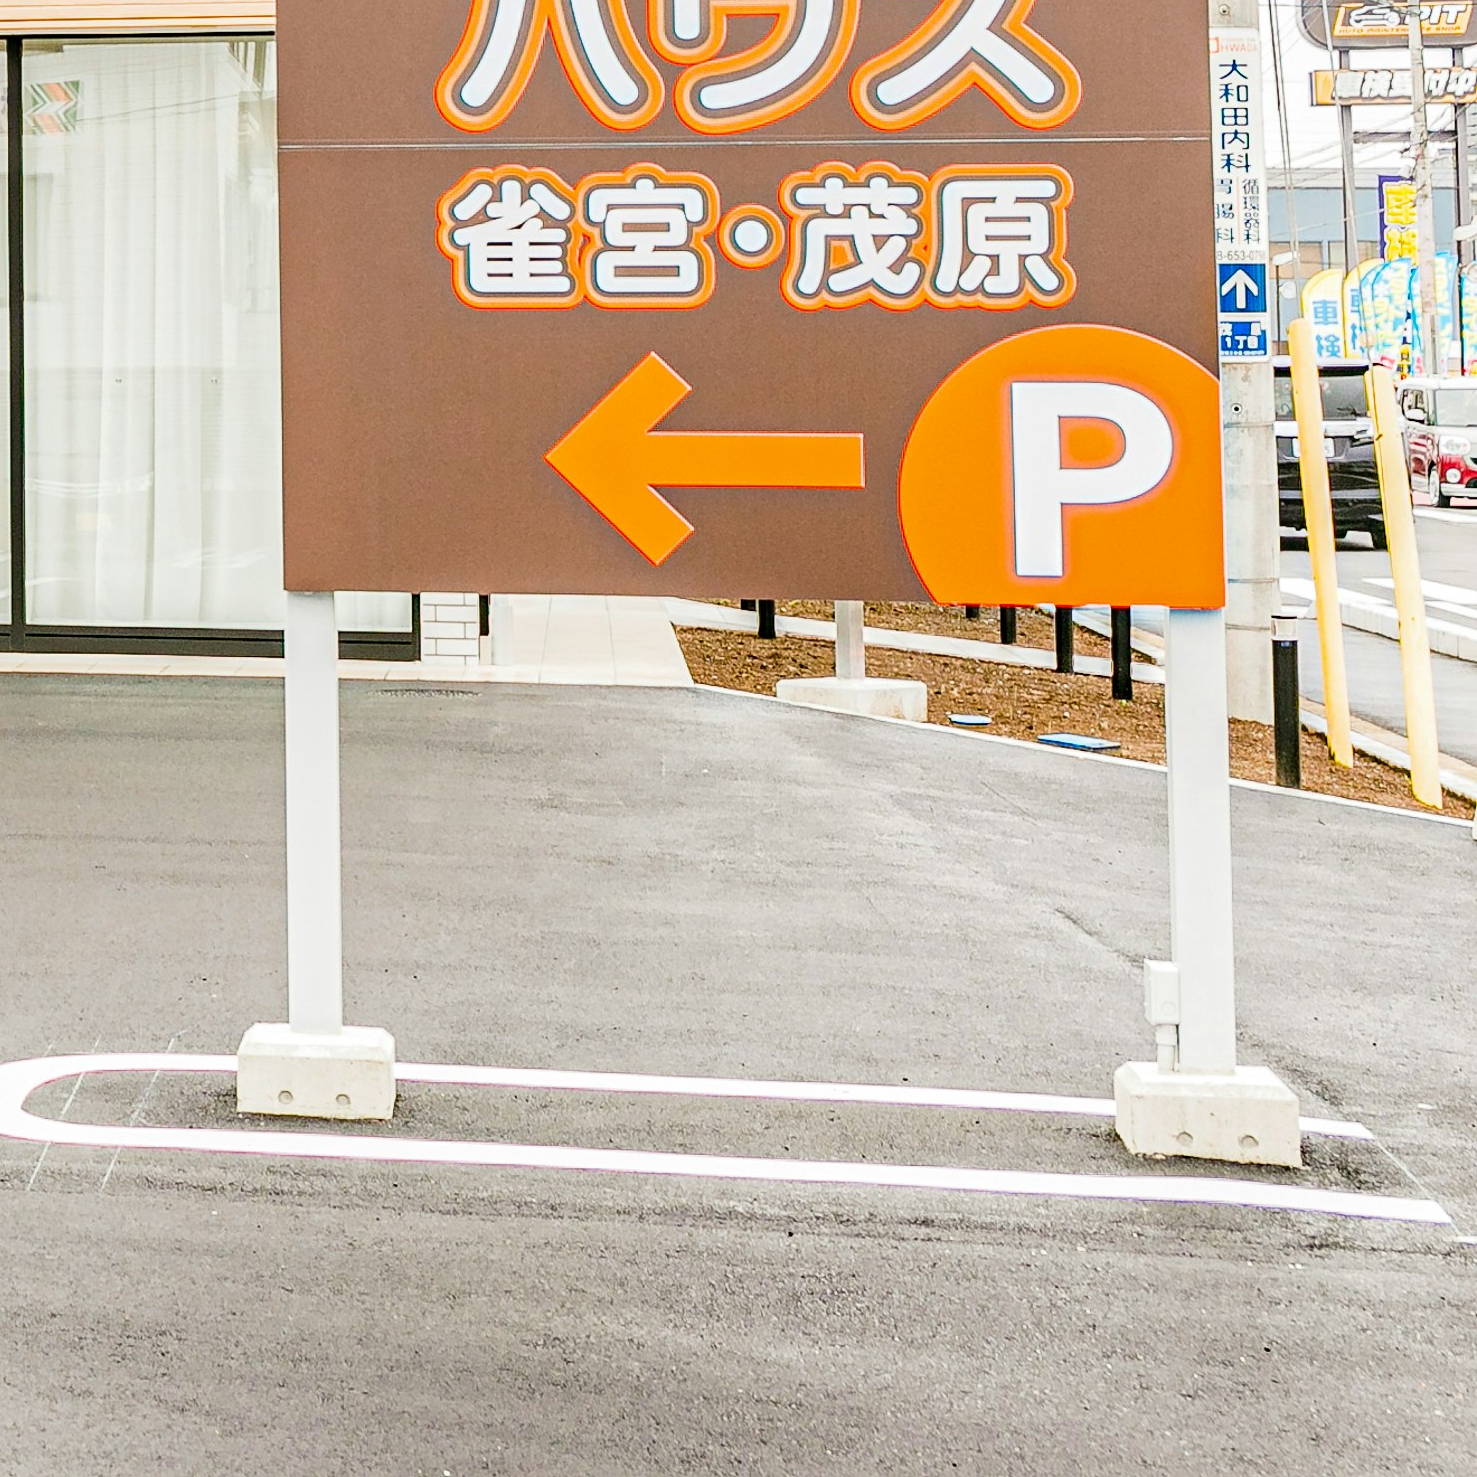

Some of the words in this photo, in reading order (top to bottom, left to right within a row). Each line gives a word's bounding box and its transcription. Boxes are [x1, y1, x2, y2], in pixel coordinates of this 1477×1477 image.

[1218, 59, 1252, 173] 大和田内科
[443, 170, 1068, 304] 雀宮・茂原
[1312, 299, 1341, 358] 車検
[1010, 381, 1174, 577] P
